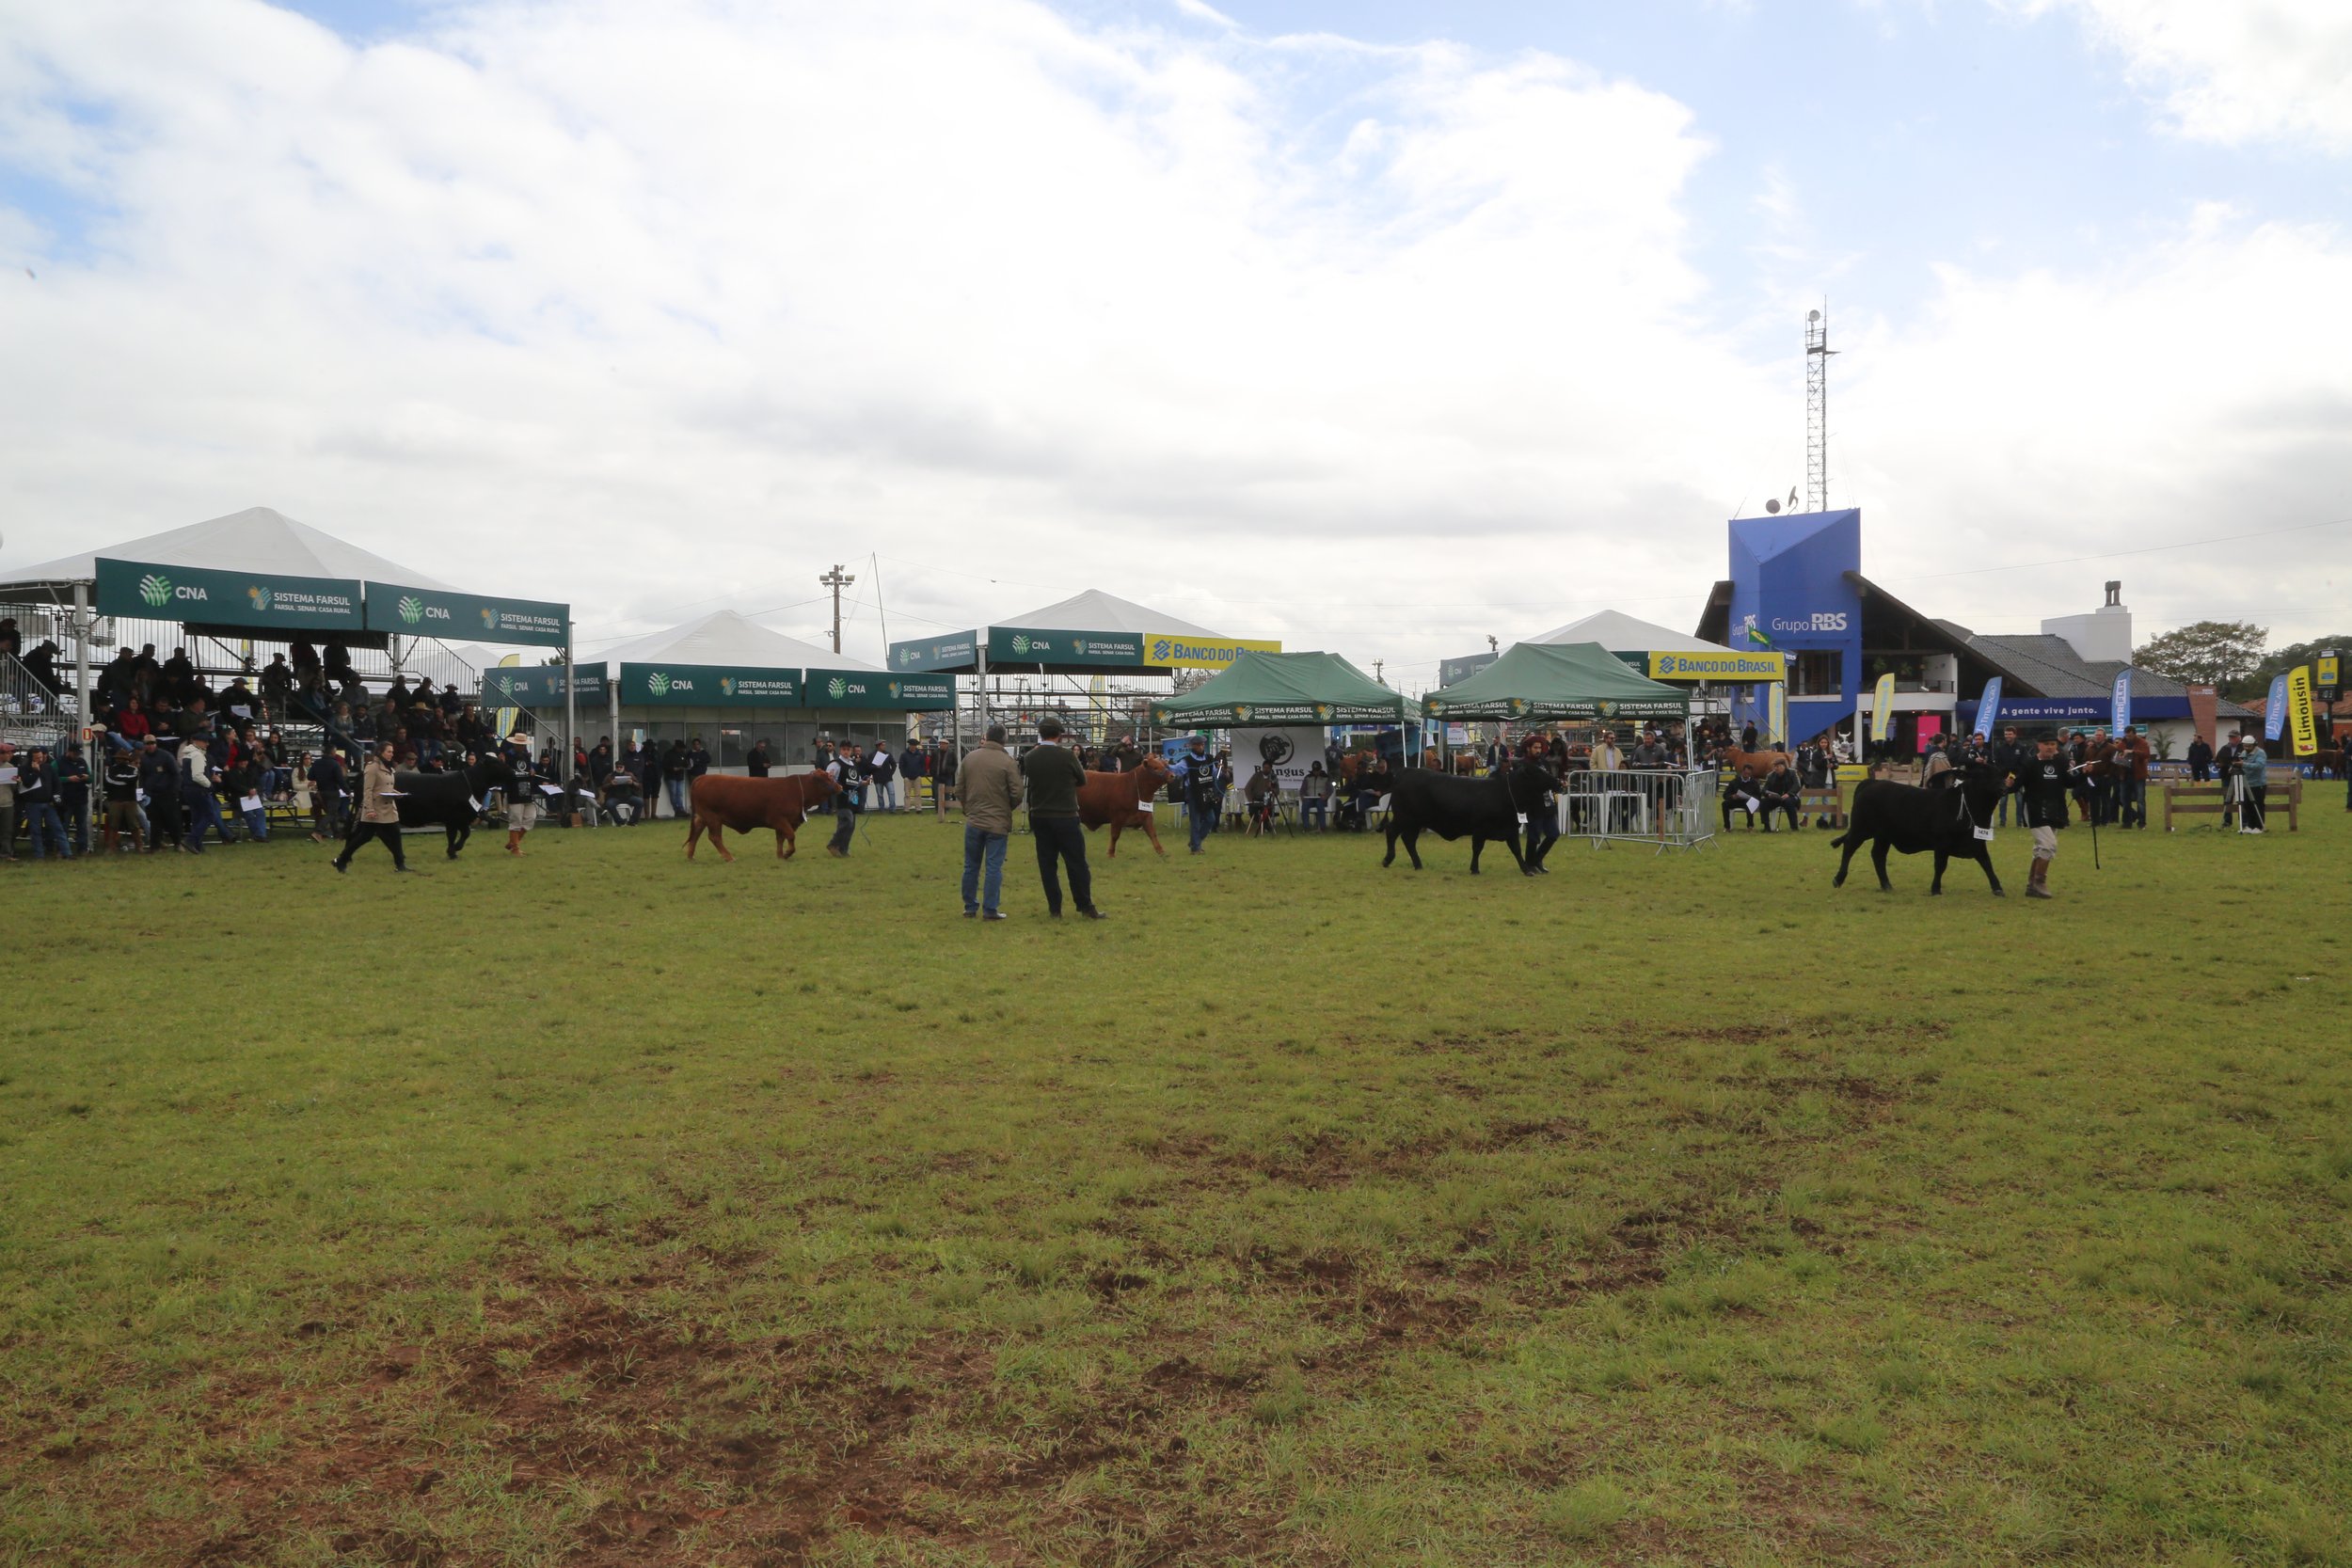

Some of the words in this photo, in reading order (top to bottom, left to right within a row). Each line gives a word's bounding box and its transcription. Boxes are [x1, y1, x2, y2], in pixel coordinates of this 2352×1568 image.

[175, 586, 208, 601] CNA
[274, 592, 314, 604] SISTEMA
[316, 594, 350, 606] FARSUL
[425, 607, 451, 620] CNA
[501, 613, 532, 624] SISTEMA
[533, 615, 561, 626] FARSUL
[1772, 617, 1809, 634] Grupo
[1811, 612, 1848, 631] RBS
[1031, 641, 1050, 650] CNA
[1174, 643, 1216, 660] BANCO
[1218, 648, 1234, 661] DO
[1678, 658, 1720, 673] BANCO
[1720, 661, 1736, 673] DO
[1738, 658, 1776, 673] BRASIL
[514, 682, 529, 691] CNA
[672, 680, 693, 690] CNA
[739, 680, 767, 689] SISTEMA
[768, 681, 792, 689] FARSUL
[848, 684, 866, 694] CNA
[1533, 702, 1565, 710] SISTEMA
[2001, 707, 2008, 716] A
[2011, 707, 2041, 716] gente
[2044, 706, 2064, 715] vive
[2068, 705, 2098, 715] junto.
[2294, 677, 2312, 741] Limousin
[1174, 710, 1204, 719] SISTEMA
[1205, 708, 1232, 717] FARSUL
[1254, 765, 1305, 778] Bngus
